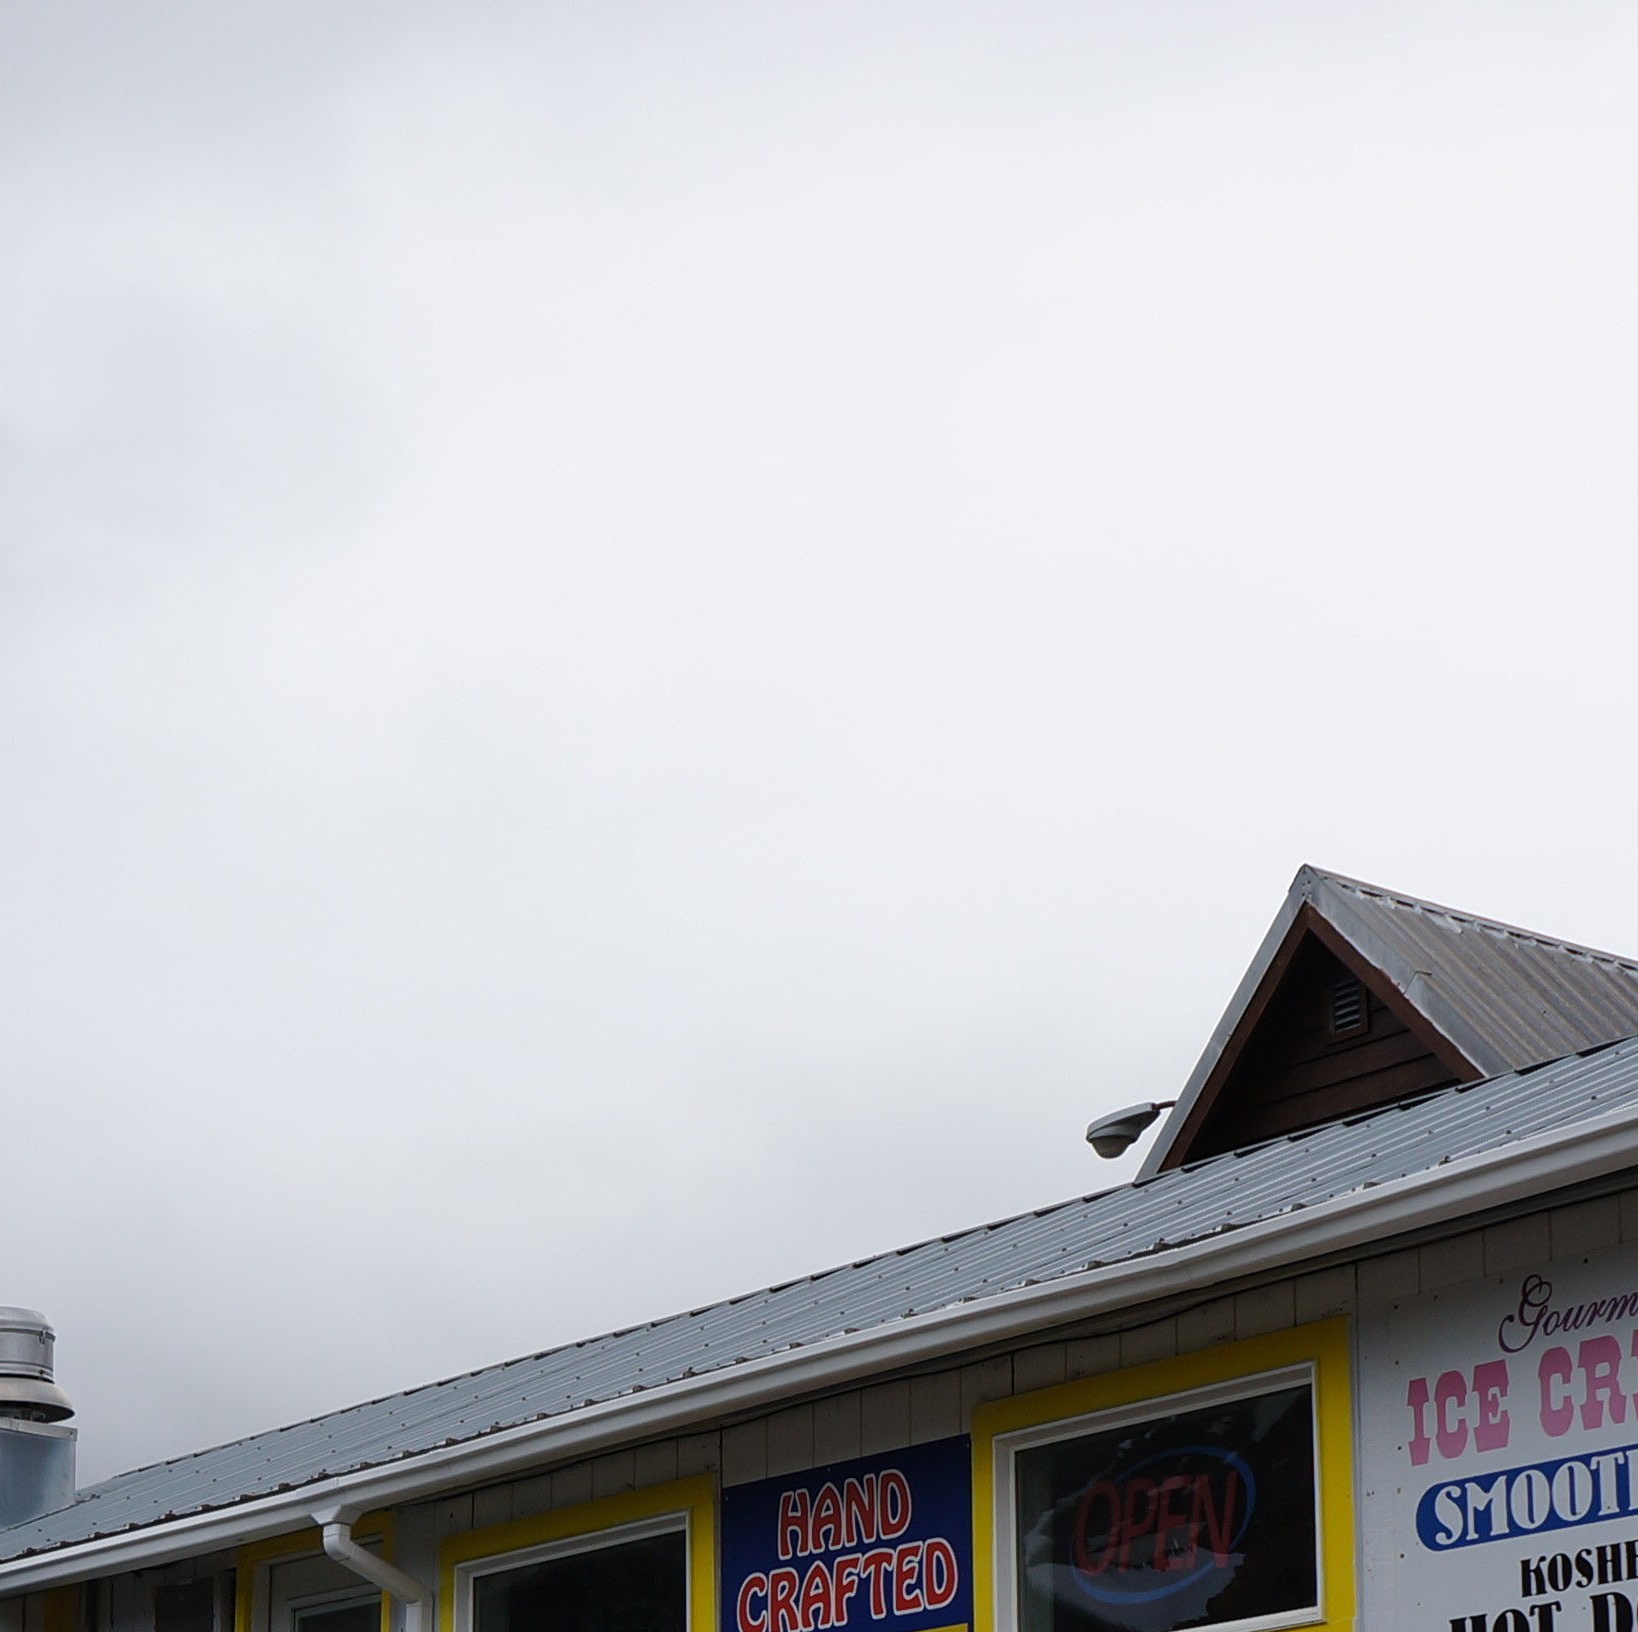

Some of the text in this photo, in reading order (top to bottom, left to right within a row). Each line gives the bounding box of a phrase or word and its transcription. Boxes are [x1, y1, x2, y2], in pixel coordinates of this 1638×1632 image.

[1406, 1359, 1510, 1467] ICE
[778, 1468, 912, 1560] HAND
[1074, 1471, 1239, 1576] OPEN
